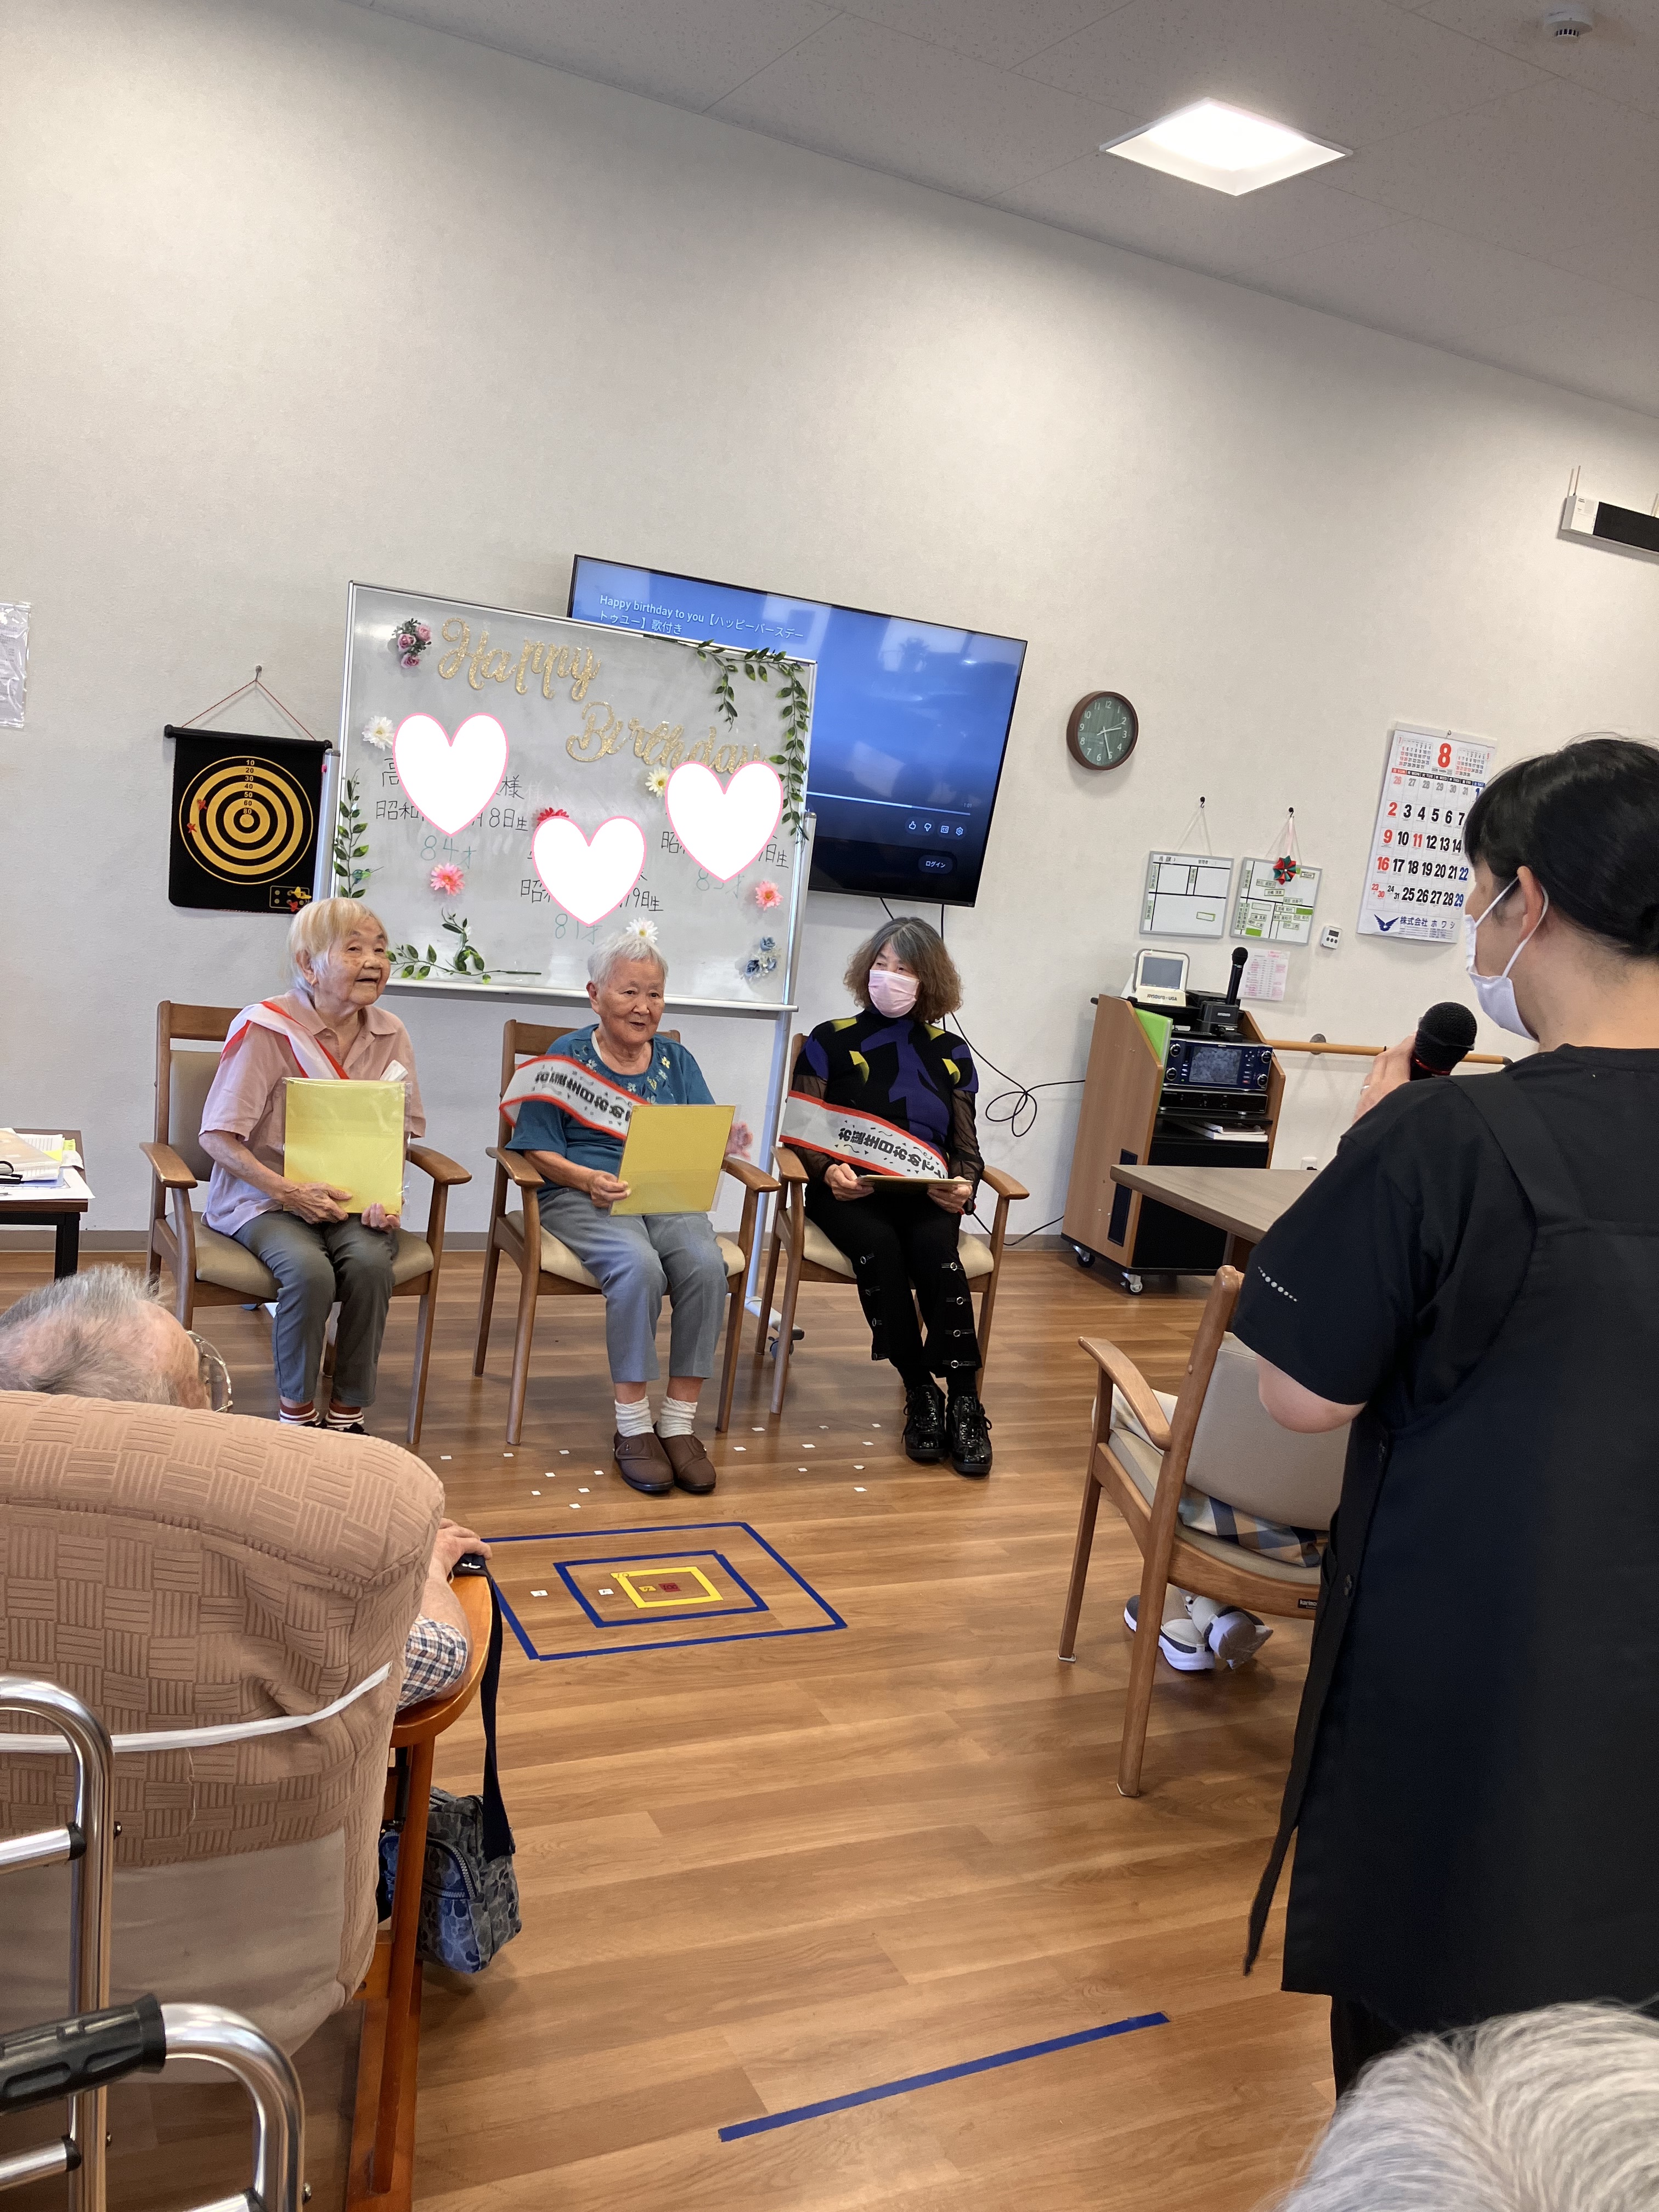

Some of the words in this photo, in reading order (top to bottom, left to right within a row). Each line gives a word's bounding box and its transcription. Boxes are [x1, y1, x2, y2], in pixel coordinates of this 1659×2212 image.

[600, 595, 631, 611] Happy
[633, 600, 673, 618] birthday
[675, 609, 685, 619] to
[438, 617, 602, 702] Happy
[1094, 702, 1101, 710] 11
[1105, 701, 1112, 709] 12
[1084, 710, 1091, 719] 10
[1121, 717, 1127, 725] 2
[1079, 723, 1085, 731] 9
[1122, 730, 1127, 738] 3
[1080, 737, 1085, 745] 8
[1117, 743, 1122, 751] 4
[1097, 753, 1102, 761] 6
[1438, 743, 1452, 768] 8
[1393, 776, 1402, 785] 26
[1408, 778, 1416, 787] 27
[1422, 780, 1430, 789] 28
[1436, 782, 1443, 791] 29
[1449, 785, 1457, 793] 30
[1463, 787, 1468, 795] 31
[376, 800, 424, 821] 昭和
[1388, 802, 1397, 816] 2
[1403, 804, 1412, 818] 3
[1418, 806, 1425, 820] 4
[1431, 808, 1440, 822] 5
[1445, 810, 1452, 823] 6
[1458, 812, 1465, 826] 7
[1383, 830, 1392, 843] 9
[1398, 831, 1409, 845] 10
[1413, 833, 1423, 847] 11
[1426, 836, 1437, 849] 12
[1440, 837, 1450, 851] 13
[1453, 839, 1462, 853] 14
[926, 860, 946, 868] ログイン
[1377, 856, 1389, 871] 16
[1393, 858, 1405, 872] 17
[1408, 860, 1419, 874] 18
[1422, 862, 1432, 876] 19
[1434, 864, 1446, 878] 20
[1447, 865, 1458, 879] 21
[1459, 867, 1469, 881] 22
[1401, 887, 1415, 901] 25
[1416, 889, 1429, 903] 26
[1430, 890, 1442, 904] 27
[1442, 891, 1454, 906] 28
[1454, 893, 1464, 907] 29
[1400, 916, 1427, 927] 株式会社
[535, 1070, 630, 1121] お誕生日おめ
